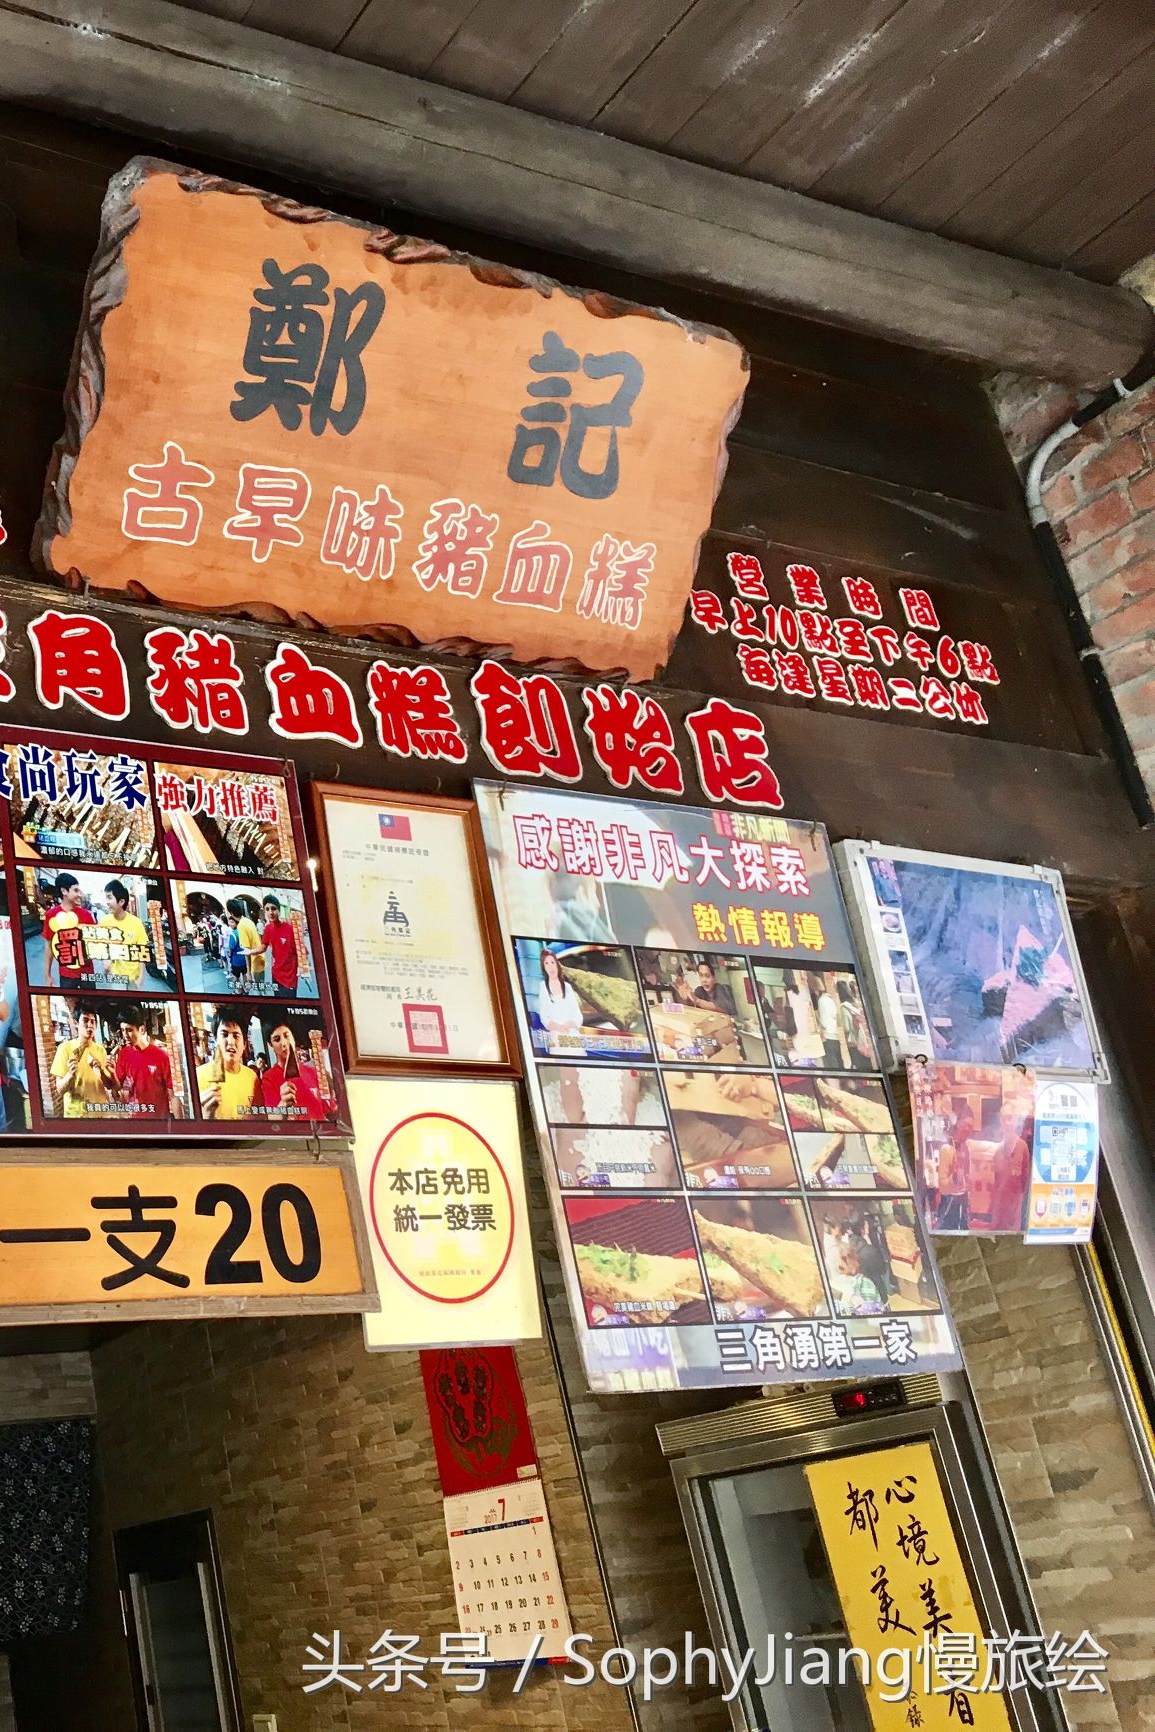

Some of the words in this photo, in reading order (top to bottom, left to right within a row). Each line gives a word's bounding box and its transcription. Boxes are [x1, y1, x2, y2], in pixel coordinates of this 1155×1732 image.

[230, 257, 645, 500] 鄭記
[121, 441, 656, 630] 古早味豬血糕
[727, 552, 940, 631] 營業時間
[690, 589, 1001, 685] 早上10點至下午6點
[154, 772, 280, 824] 強力推薦
[512, 814, 811, 898] 感謝非凡大探索
[692, 902, 826, 952] 熱情報導
[388, 1168, 491, 1196] 本店免用
[393, 1204, 497, 1233] 統一發票
[715, 1319, 917, 1374] 三角湧第一家
[497, 1498, 506, 1521] 7
